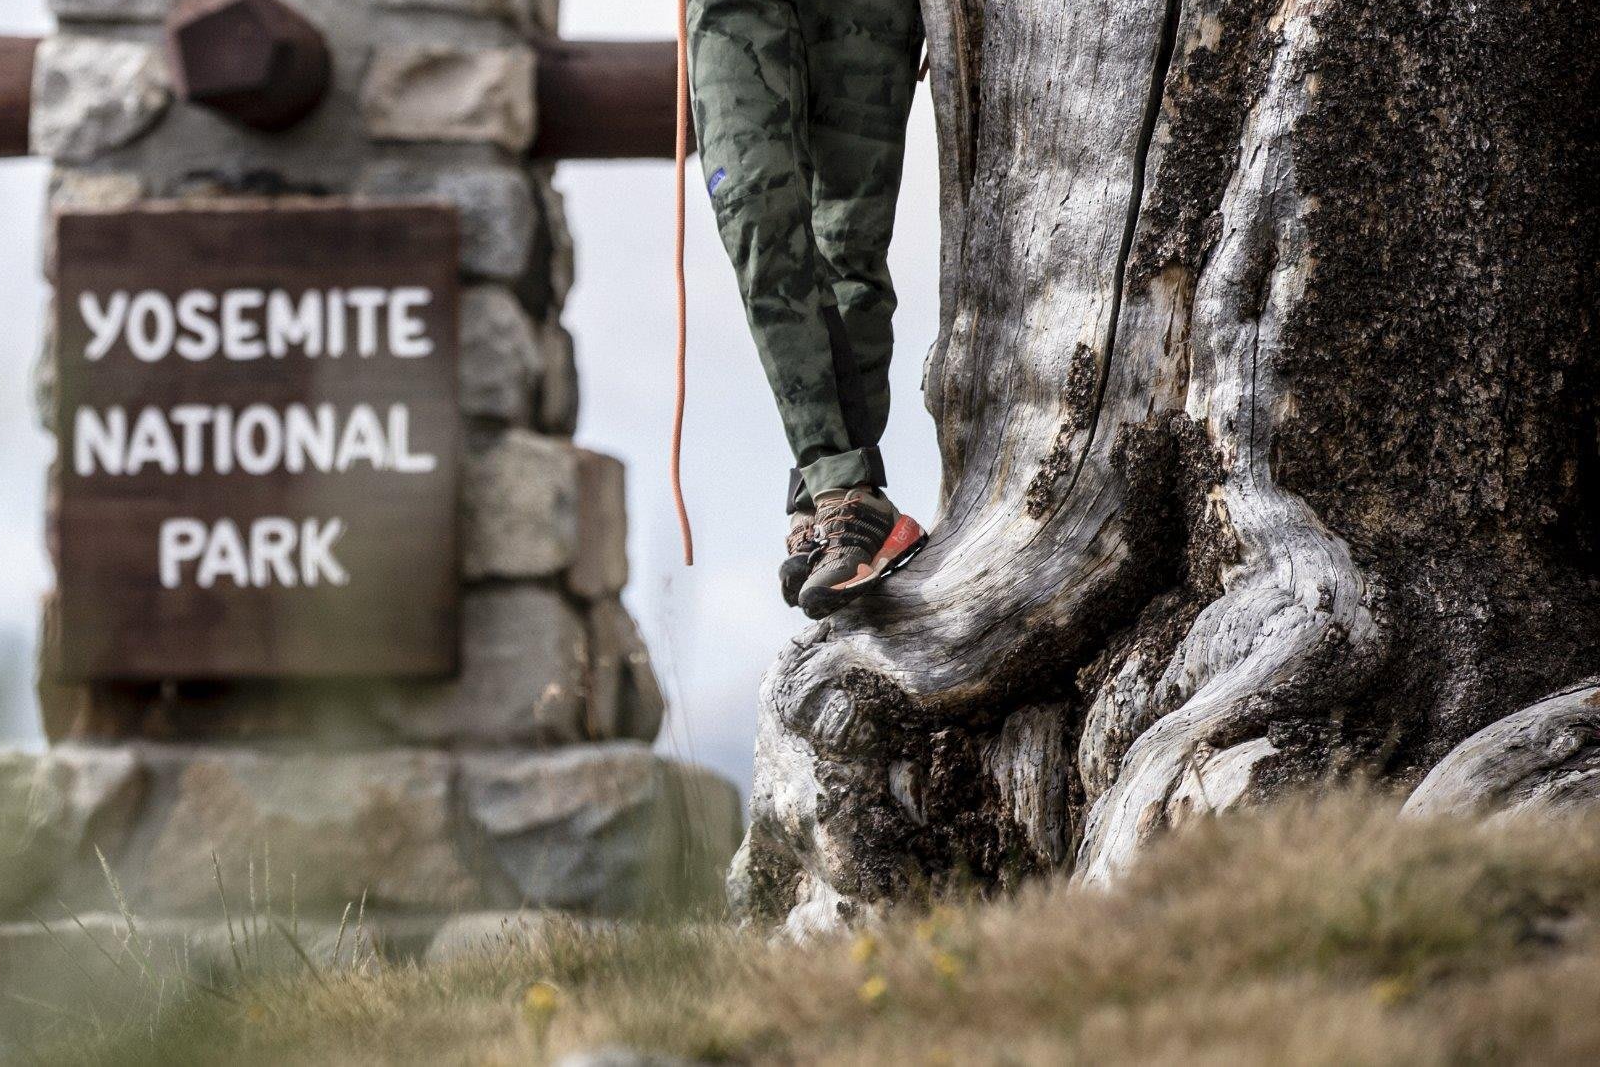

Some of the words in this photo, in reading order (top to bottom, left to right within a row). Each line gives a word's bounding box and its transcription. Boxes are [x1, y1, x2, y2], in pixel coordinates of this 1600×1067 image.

[79, 287, 434, 362] YOSEMITE
[73, 402, 437, 475] NATIONAL
[159, 516, 349, 588] PARK
